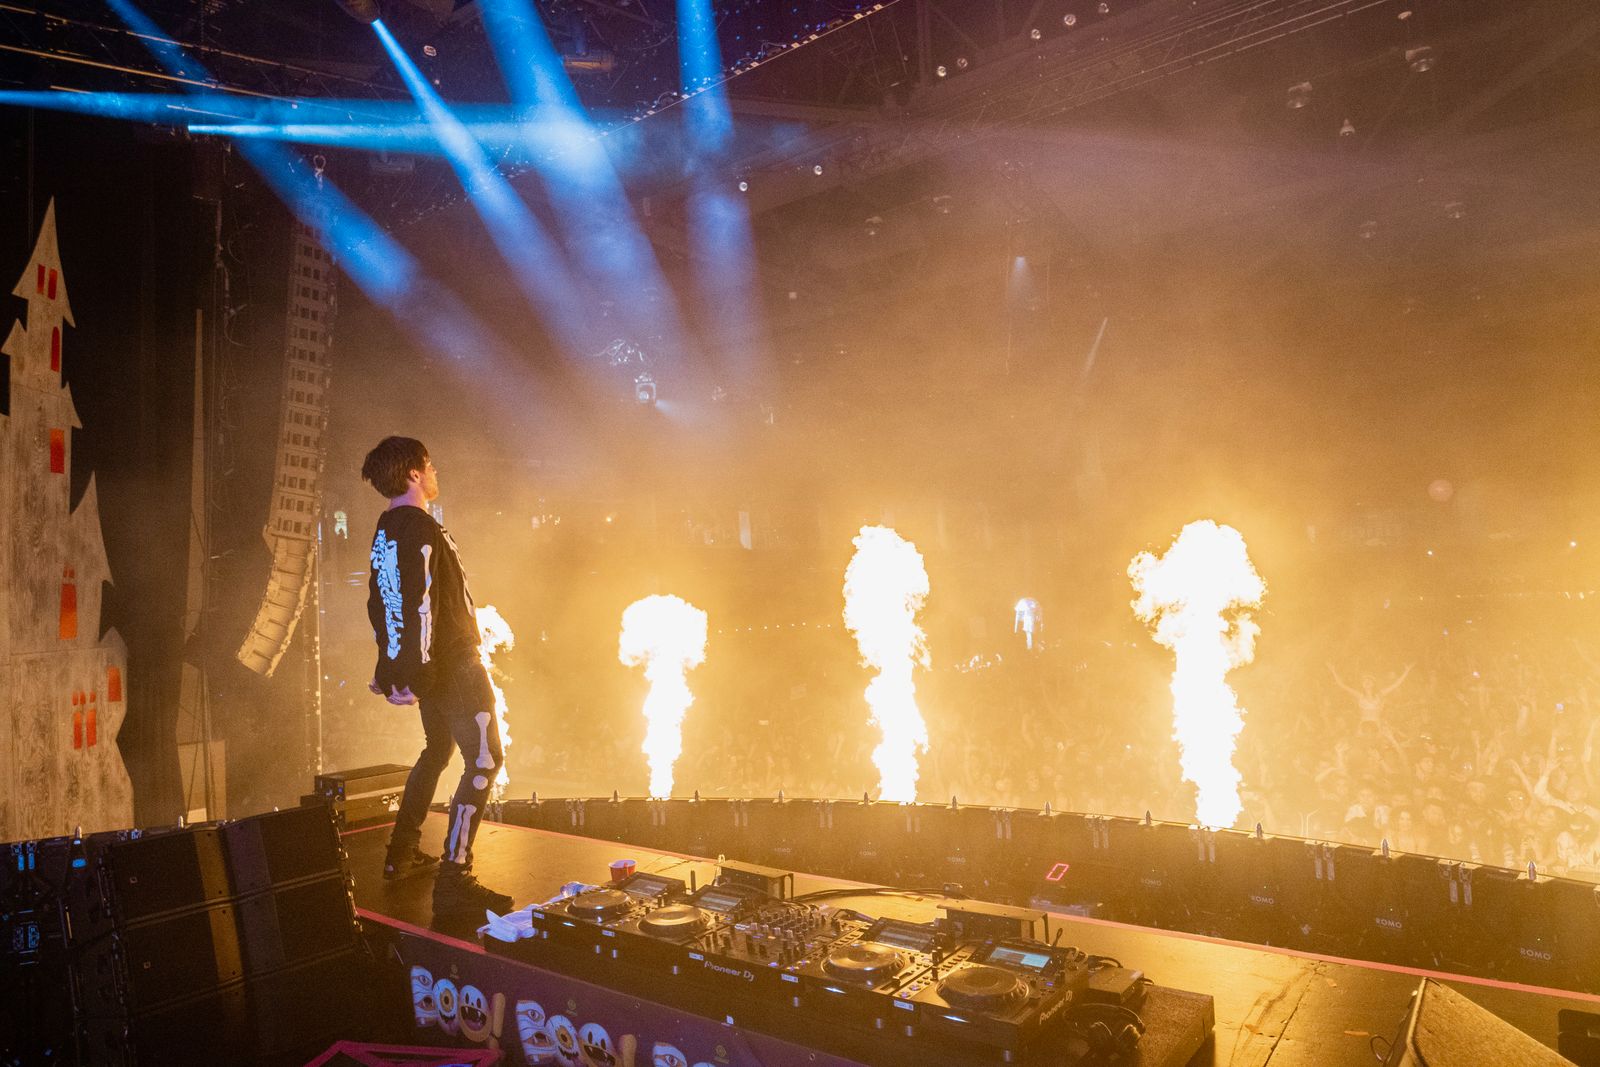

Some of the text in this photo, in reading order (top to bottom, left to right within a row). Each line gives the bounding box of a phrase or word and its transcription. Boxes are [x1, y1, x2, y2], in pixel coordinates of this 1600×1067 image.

[1375, 917, 1402, 929] ROMO
[1520, 947, 1552, 961] ROMO
[704, 961, 741, 976] Pioneer
